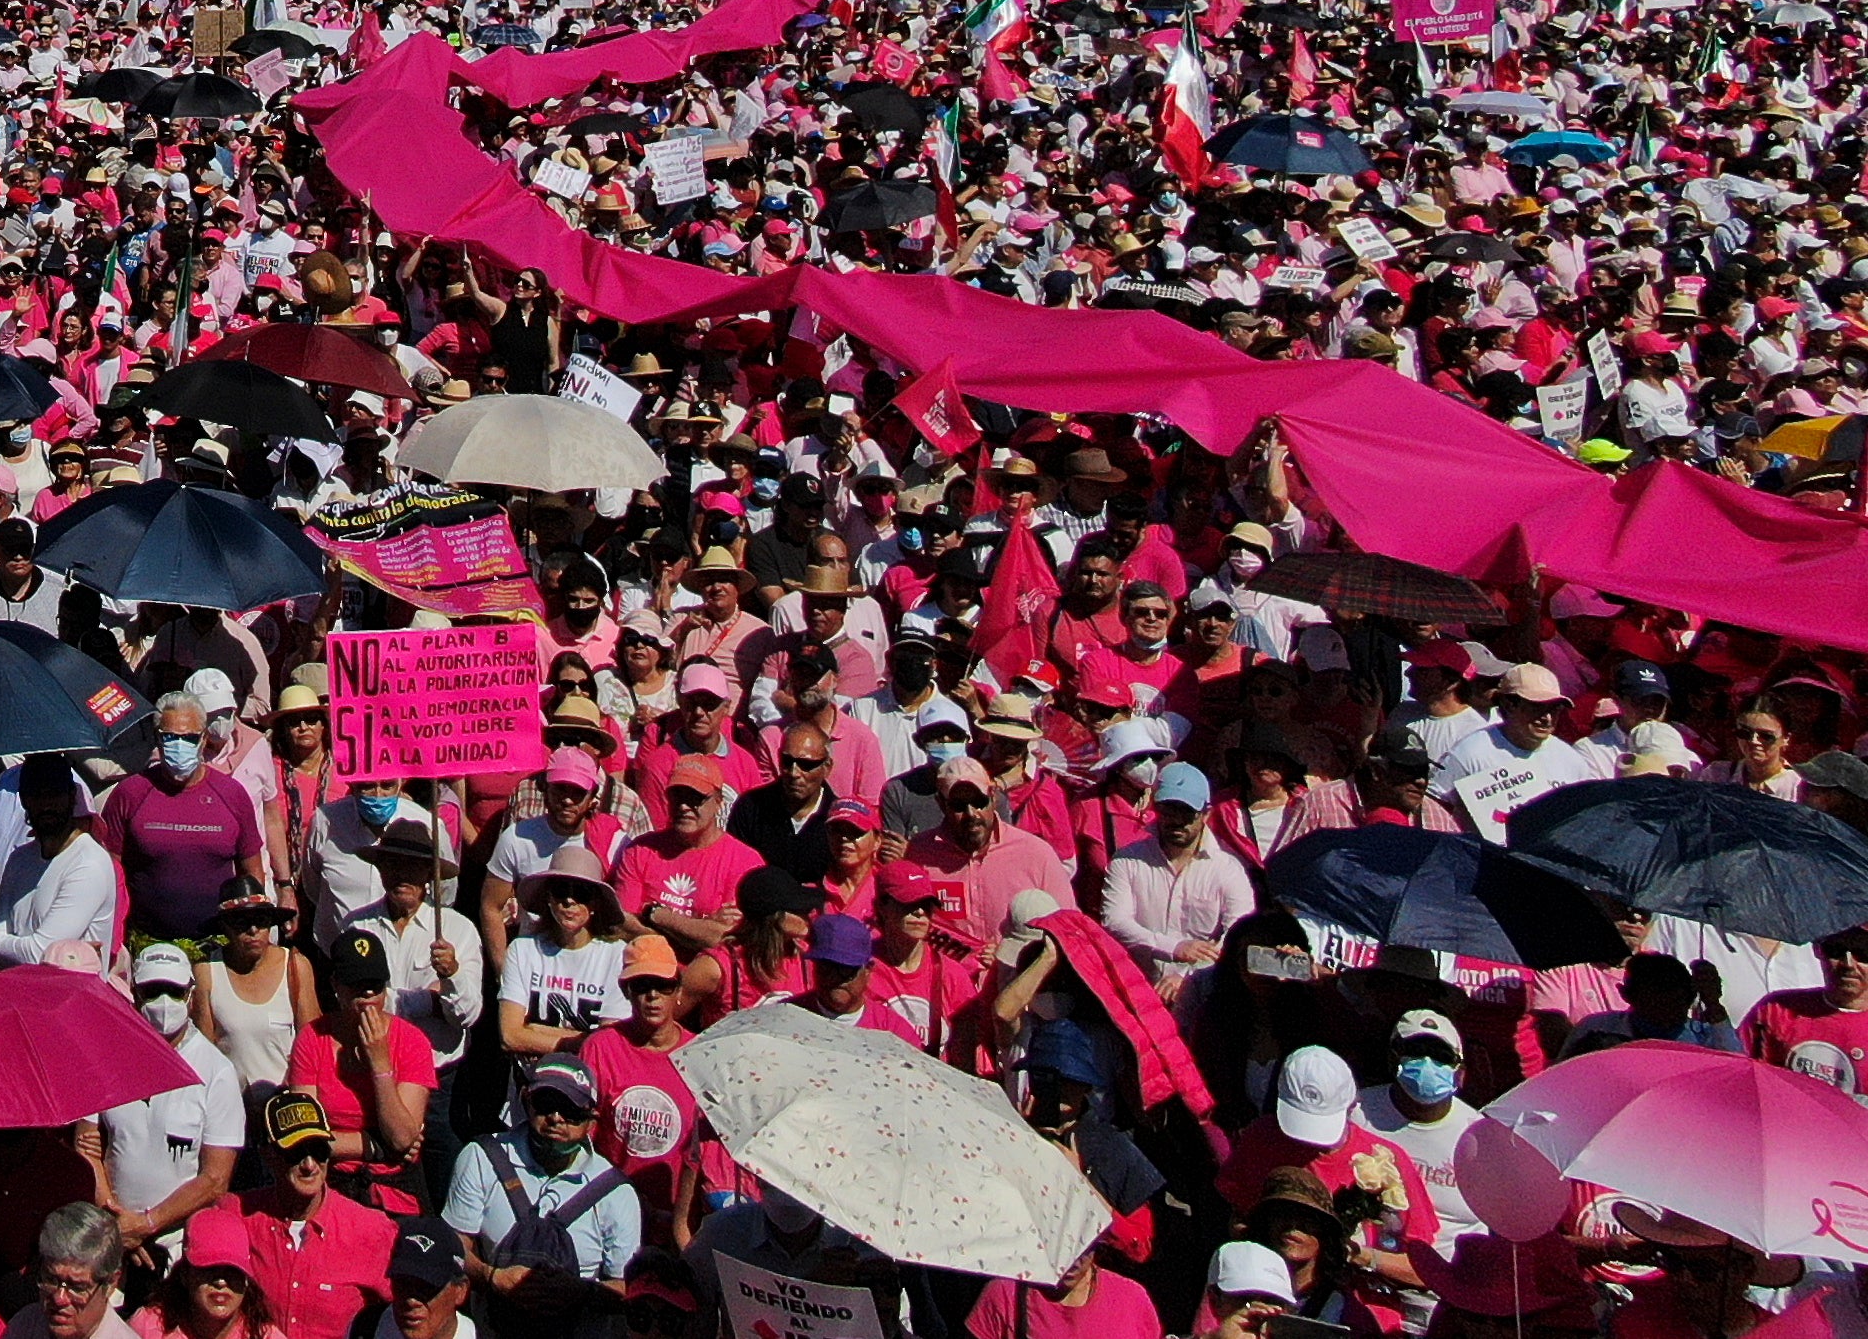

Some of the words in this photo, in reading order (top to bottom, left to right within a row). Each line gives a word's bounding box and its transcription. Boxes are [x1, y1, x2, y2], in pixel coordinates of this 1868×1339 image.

[392, 501, 404, 516] la
[442, 528, 469, 539] Porque
[332, 638, 380, 699] NO
[388, 637, 411, 652] AL
[422, 632, 475, 651] PLAN
[494, 630, 509, 646] B
[382, 658, 406, 673] AL
[415, 650, 536, 671] AUTORITARISMO
[381, 680, 390, 695] A
[397, 678, 417, 694] LA
[109, 698, 132, 718] INE
[382, 706, 391, 720] A
[401, 705, 419, 720] LA
[427, 697, 530, 718] DEMOCRACIA
[382, 724, 403, 739] AL
[412, 721, 453, 740] VOTO
[461, 716, 518, 734] LIBRE
[379, 748, 391, 765] A
[399, 748, 423, 766] LA
[435, 740, 508, 764] UNIDAD
[1474, 770, 1534, 800] DEFIENDO
[1490, 768, 1509, 781] YO
[1507, 790, 1523, 801] AL
[546, 974, 574, 992] INE
[576, 981, 606, 997] nos
[1492, 967, 1521, 990] NO
[621, 1105, 672, 1127] #MIVOTO
[773, 1278, 807, 1300] YO
[737, 1280, 854, 1321] DEFIENDO
[789, 1316, 814, 1331] AL
